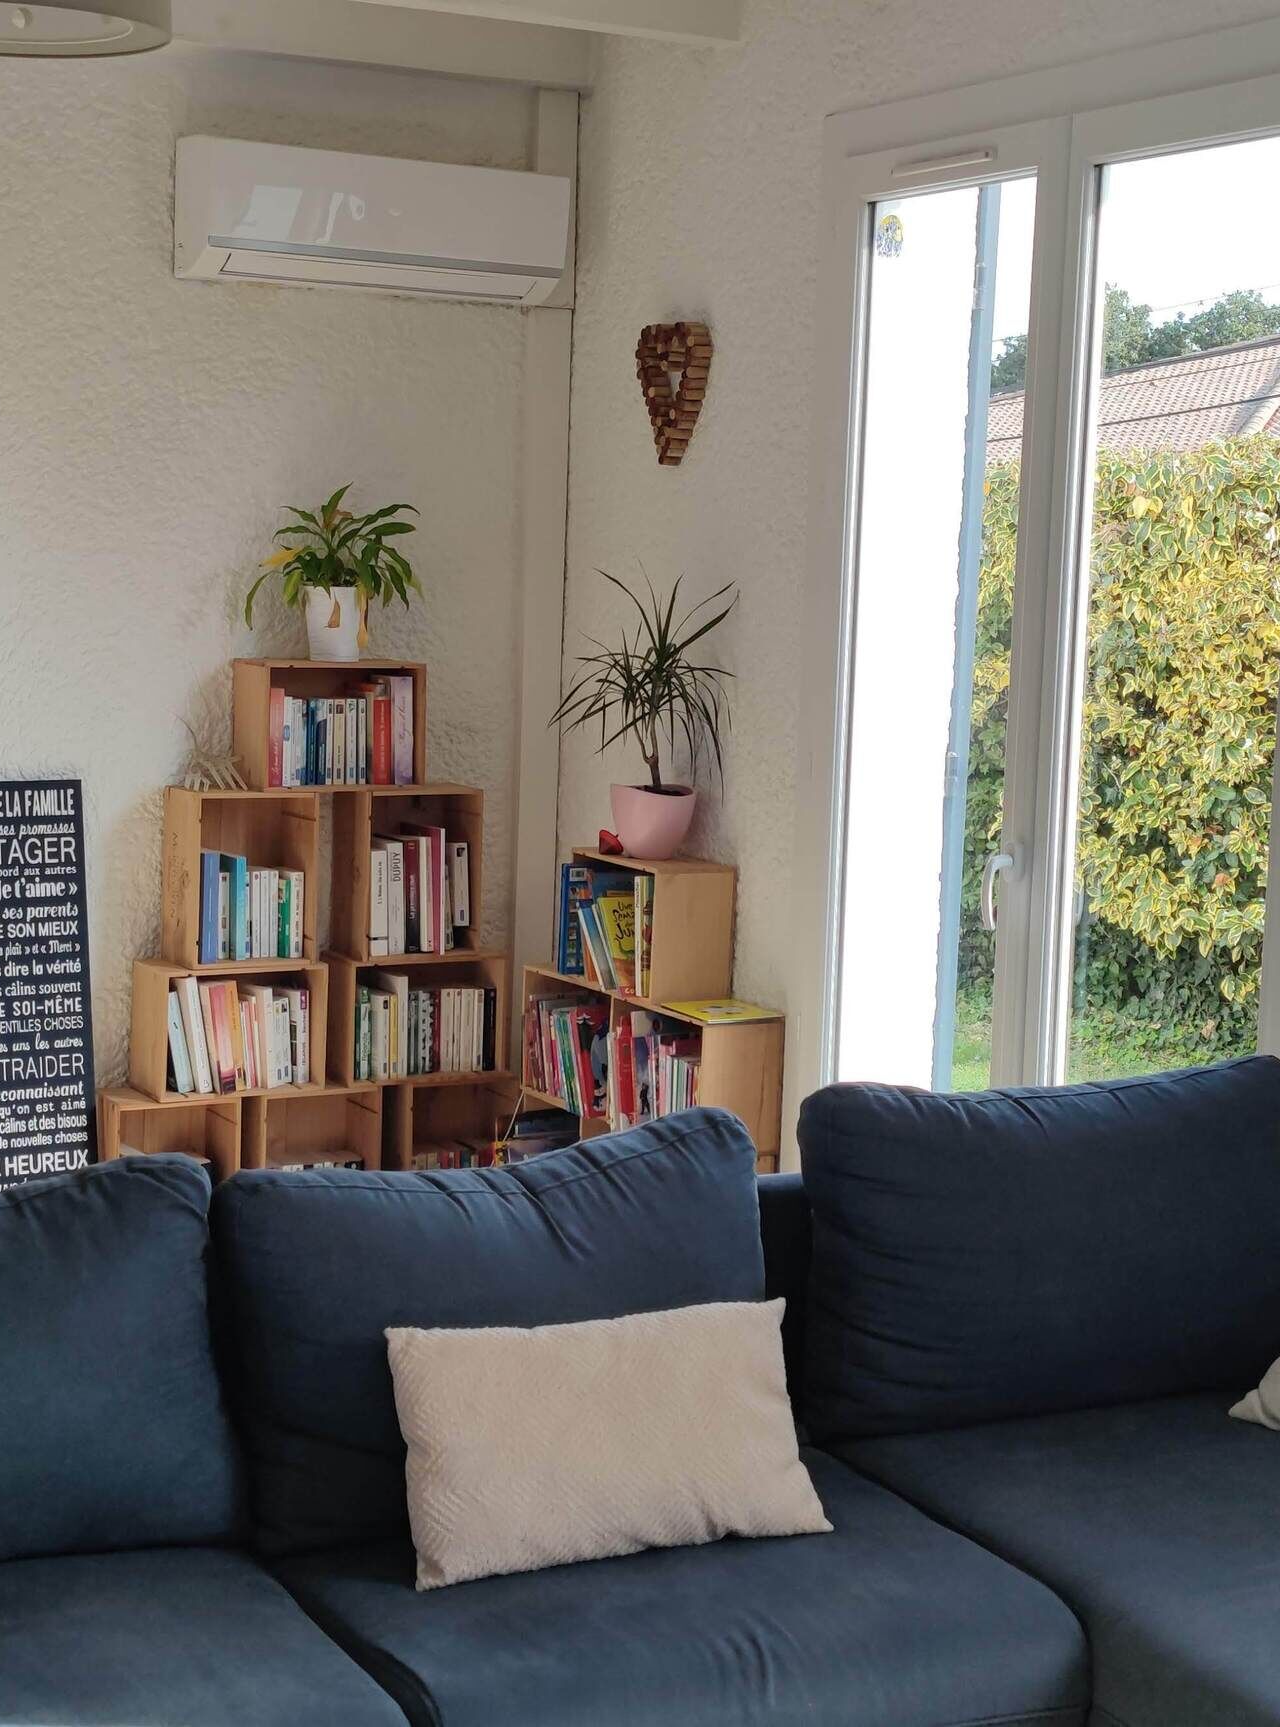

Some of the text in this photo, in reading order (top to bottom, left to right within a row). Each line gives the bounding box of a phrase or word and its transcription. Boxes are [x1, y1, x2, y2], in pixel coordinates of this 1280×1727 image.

[5, 790, 21, 817] LA
[24, 789, 75, 817] FAMILLE
[19, 822, 75, 840] promesses
[24, 868, 40, 876] aux
[45, 866, 77, 875] autres
[393, 851, 401, 882] DUPUY
[15, 877, 66, 898] t'aime
[2, 907, 23, 920] ses
[26, 901, 78, 922] parents
[7, 923, 35, 938] SON
[38, 920, 79, 937] MIEUX
[48, 940, 73, 954] Merci
[4, 961, 29, 977] dire
[32, 959, 43, 975] la
[46, 958, 82, 974] vérité
[5, 980, 36, 997] câlins
[38, 981, 82, 994] souvent
[12, 994, 83, 1016] SOI-MÊME
[44, 1016, 84, 1031] CHOSES
[12, 1042, 31, 1051] uns
[35, 1032, 50, 1050] les
[54, 1037, 84, 1048] autres
[36, 1102, 55, 1113] est
[61, 1097, 86, 1111] aimé
[0, 1118, 27, 1135] câlins
[28, 1115, 39, 1131] et
[39, 1114, 56, 1130] des
[57, 1112, 88, 1129] bisous
[10, 1133, 53, 1148] nouvelles
[55, 1131, 88, 1144] choses
[5, 1148, 89, 1177] HEUREUX
